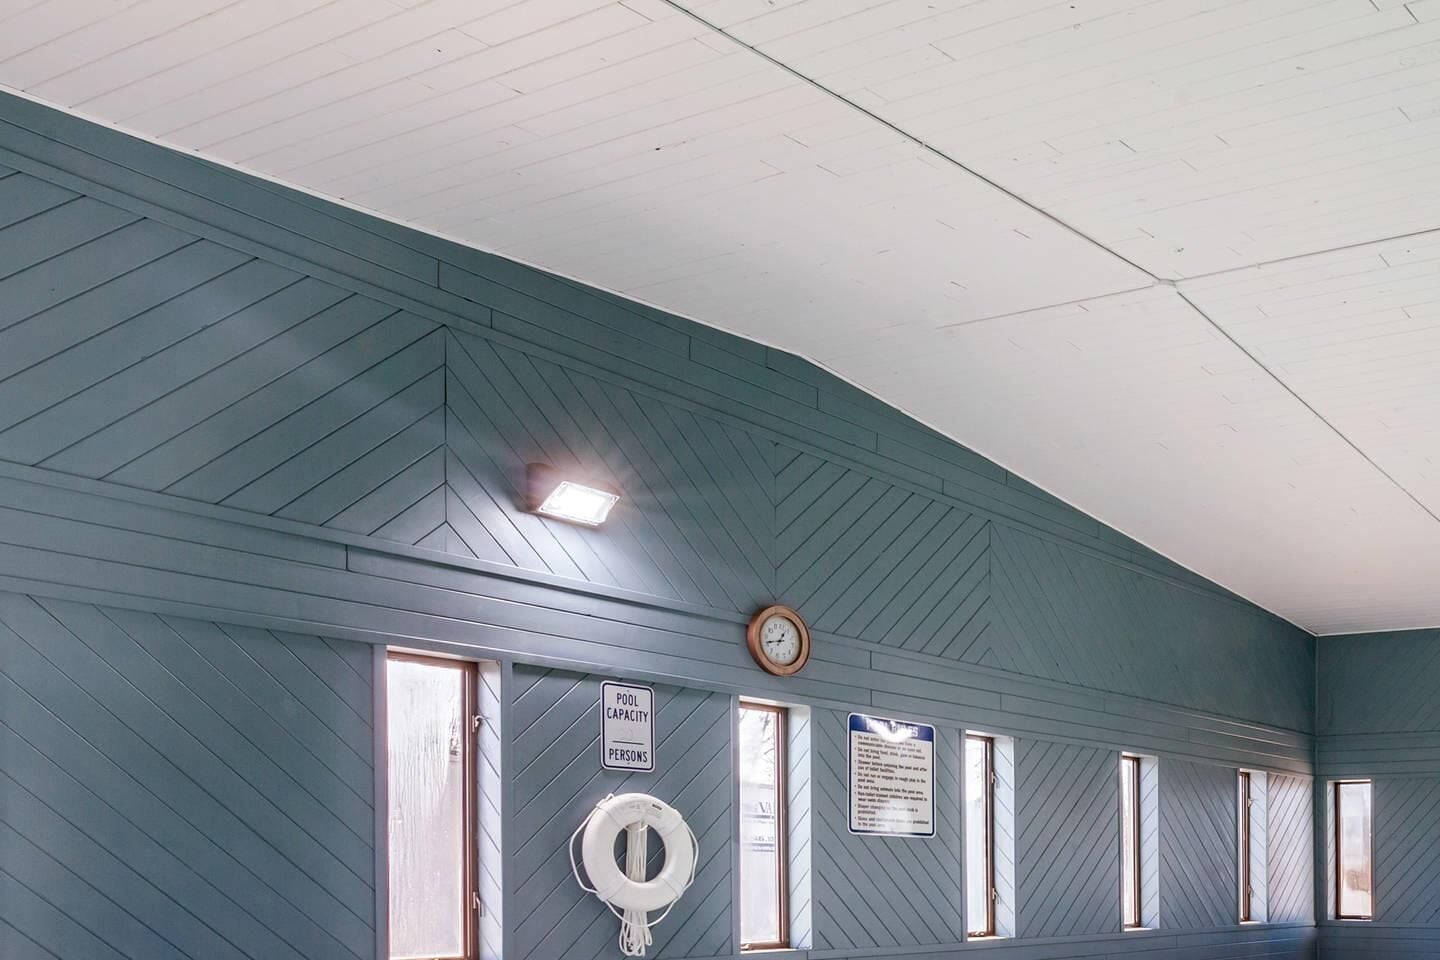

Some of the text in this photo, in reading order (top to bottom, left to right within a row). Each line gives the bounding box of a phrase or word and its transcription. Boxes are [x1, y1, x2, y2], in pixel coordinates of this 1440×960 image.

[616, 692, 638, 707] POOL
[606, 707, 649, 723] CAPACITY
[608, 748, 648, 763] PERSONS
